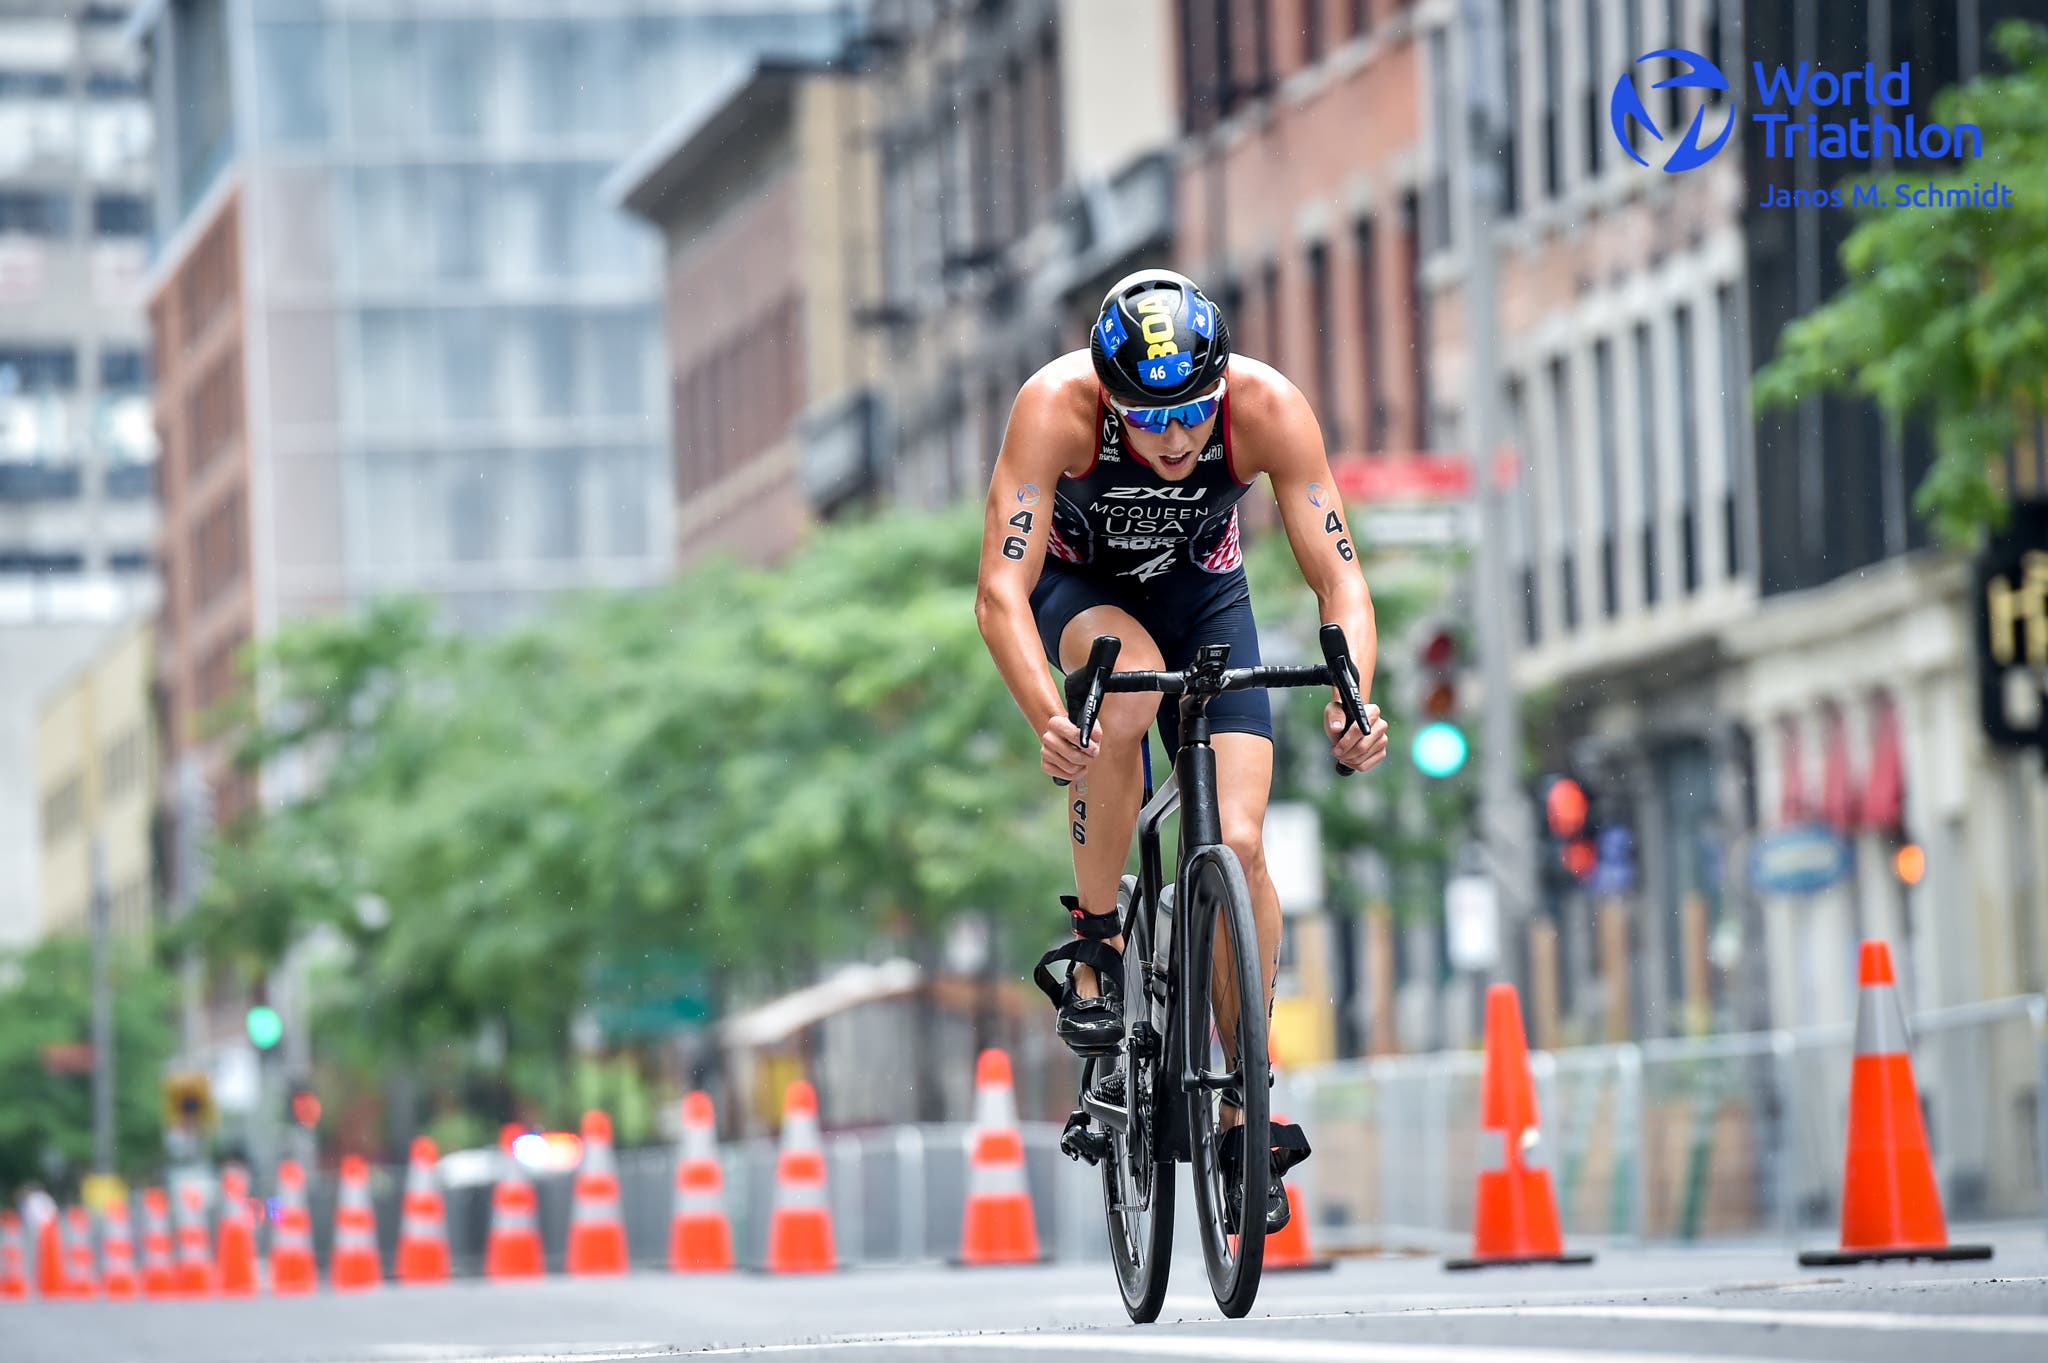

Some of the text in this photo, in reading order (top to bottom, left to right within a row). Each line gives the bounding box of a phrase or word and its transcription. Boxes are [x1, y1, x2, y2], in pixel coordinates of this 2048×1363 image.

[1149, 365, 1167, 382] 46
[1089, 501, 1209, 520] MCQUEEN
[1105, 517, 1185, 535] USA
